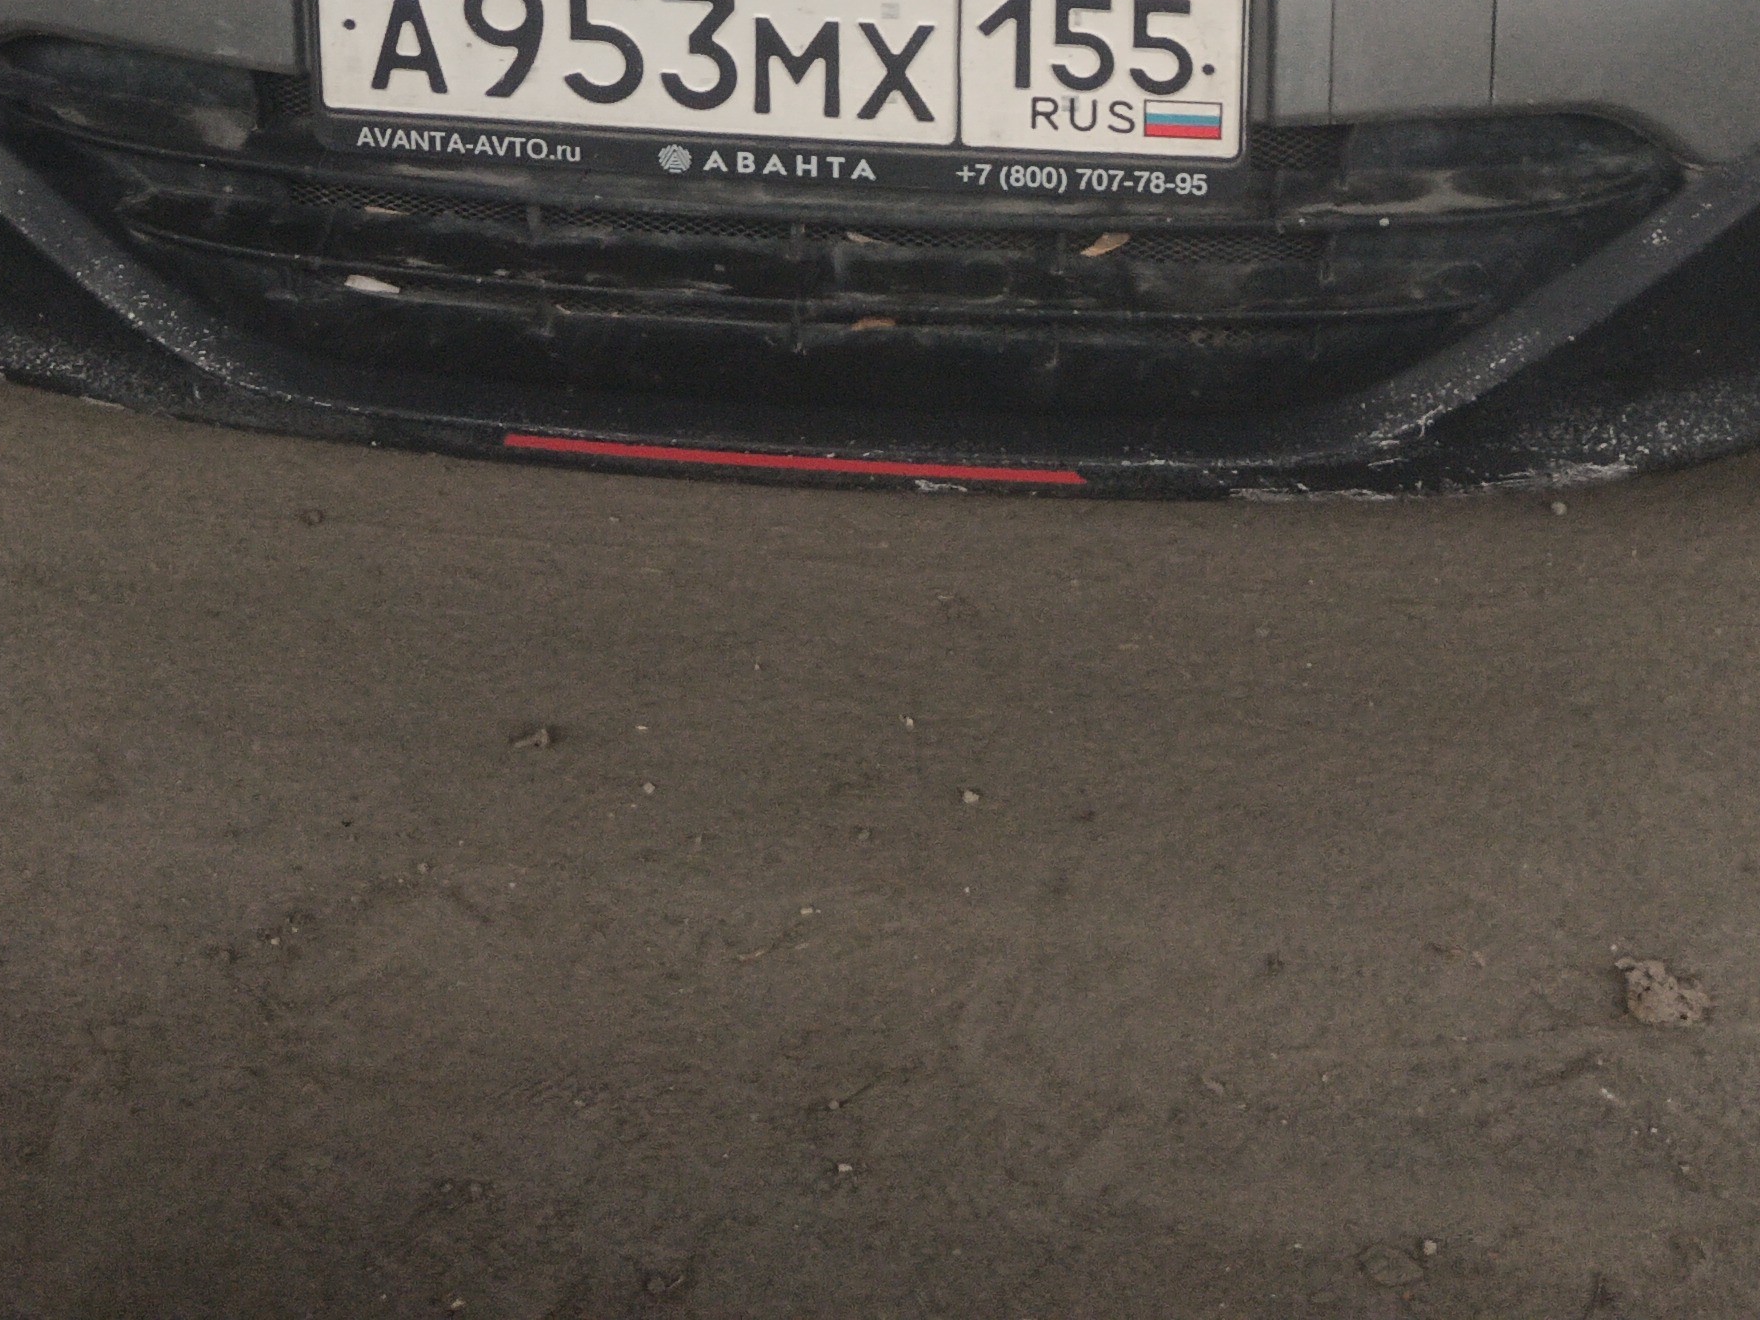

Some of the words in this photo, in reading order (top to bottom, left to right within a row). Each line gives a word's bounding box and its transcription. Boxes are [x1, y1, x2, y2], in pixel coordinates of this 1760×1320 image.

[1030, 97, 1135, 134] RUS
[356, 126, 582, 163] AVANTA-AVTO.ru
[703, 150, 877, 182] АВАНТА
[956, 163, 991, 186] +7
[999, 165, 1067, 193] (800)
[1075, 168, 1208, 196] 707-78-95
